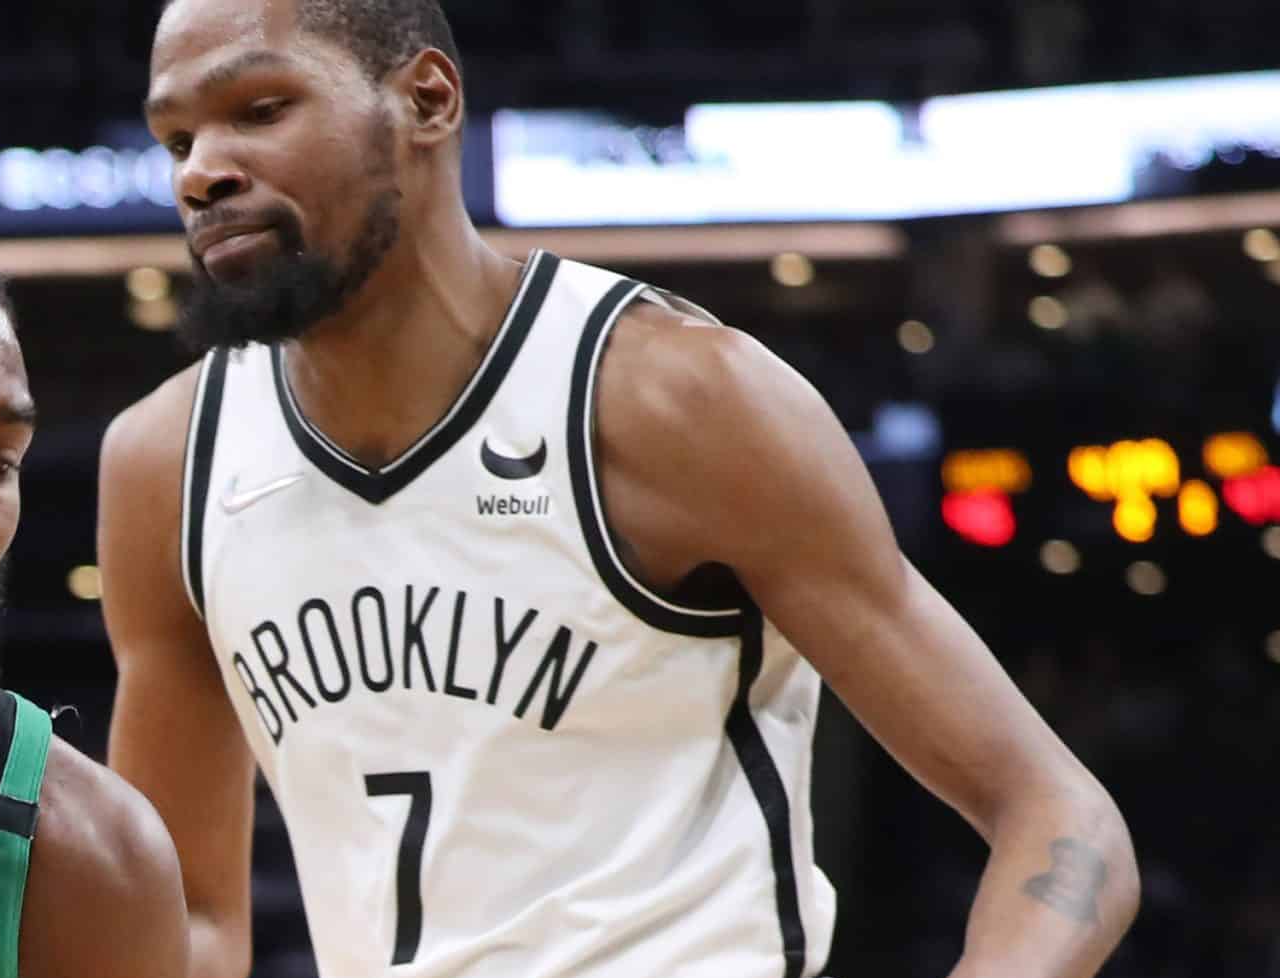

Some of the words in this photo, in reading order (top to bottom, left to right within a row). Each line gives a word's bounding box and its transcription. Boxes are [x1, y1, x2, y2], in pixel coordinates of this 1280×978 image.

[476, 495, 549, 515] Webull
[233, 584, 598, 746] BROOKLYN
[364, 771, 432, 966] 7
